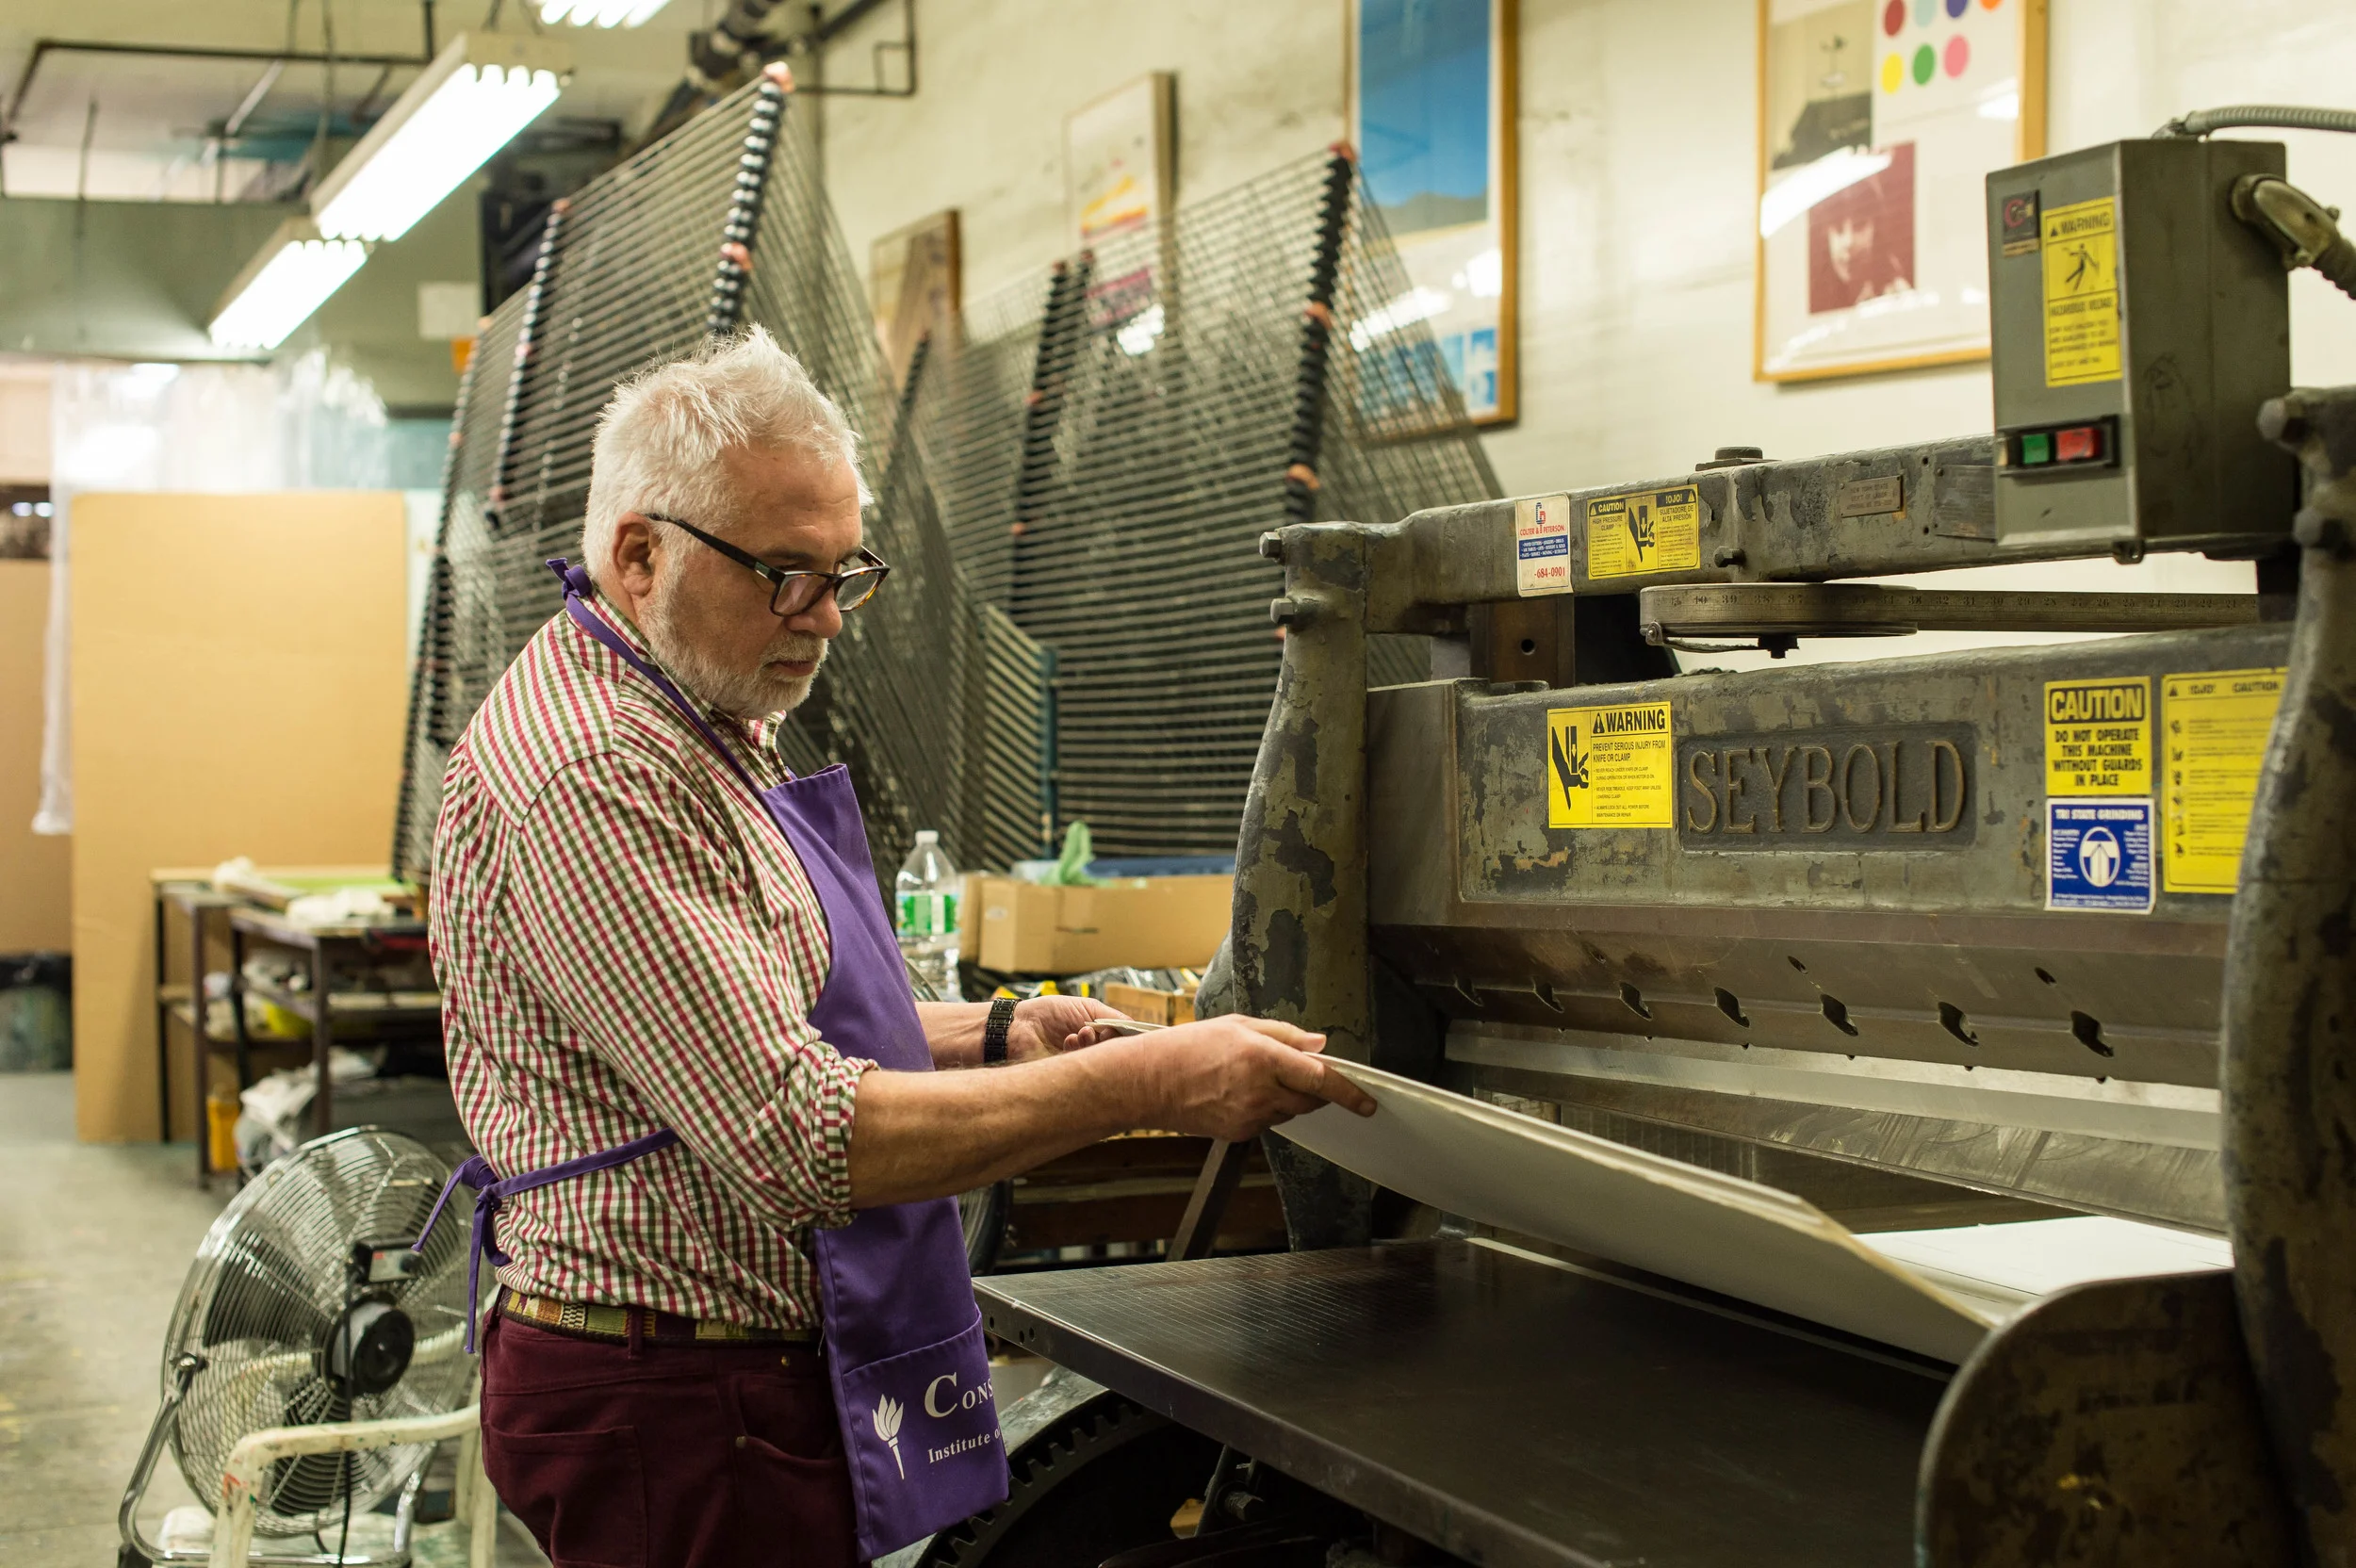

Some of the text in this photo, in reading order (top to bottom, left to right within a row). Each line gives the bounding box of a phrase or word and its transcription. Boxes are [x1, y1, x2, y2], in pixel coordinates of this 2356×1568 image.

[2060, 213, 2110, 234] WARNING
[1598, 501, 1624, 513] CAUTION
[1603, 514, 1623, 524] PRESSURE
[1520, 528, 1535, 536] COLTER
[1543, 525, 1564, 533] PETERSON
[1722, 595, 1738, 604] 39
[1935, 596, 1949, 605] 32
[2232, 681, 2280, 694] CAUTION
[2051, 687, 2143, 721] CAUTION
[1606, 709, 1665, 733] WARNING
[2054, 727, 2139, 743] DO NOT OPERATE
[1593, 740, 1665, 752] PREVENT SERIOUS INJURY FROM
[2062, 743, 2133, 757] THIS MACHINE
[1593, 755, 1607, 763] KNIFE
[1607, 754, 1613, 762] OR
[2053, 758, 2142, 772] WITHOUT GUARDS
[2075, 774, 2119, 786] IN PLACE
[1688, 739, 1965, 835] SEYBOLD
[2054, 808, 2070, 820] TRI
[2097, 808, 2144, 820] GRINDING
[928, 1433, 990, 1463] Institute
